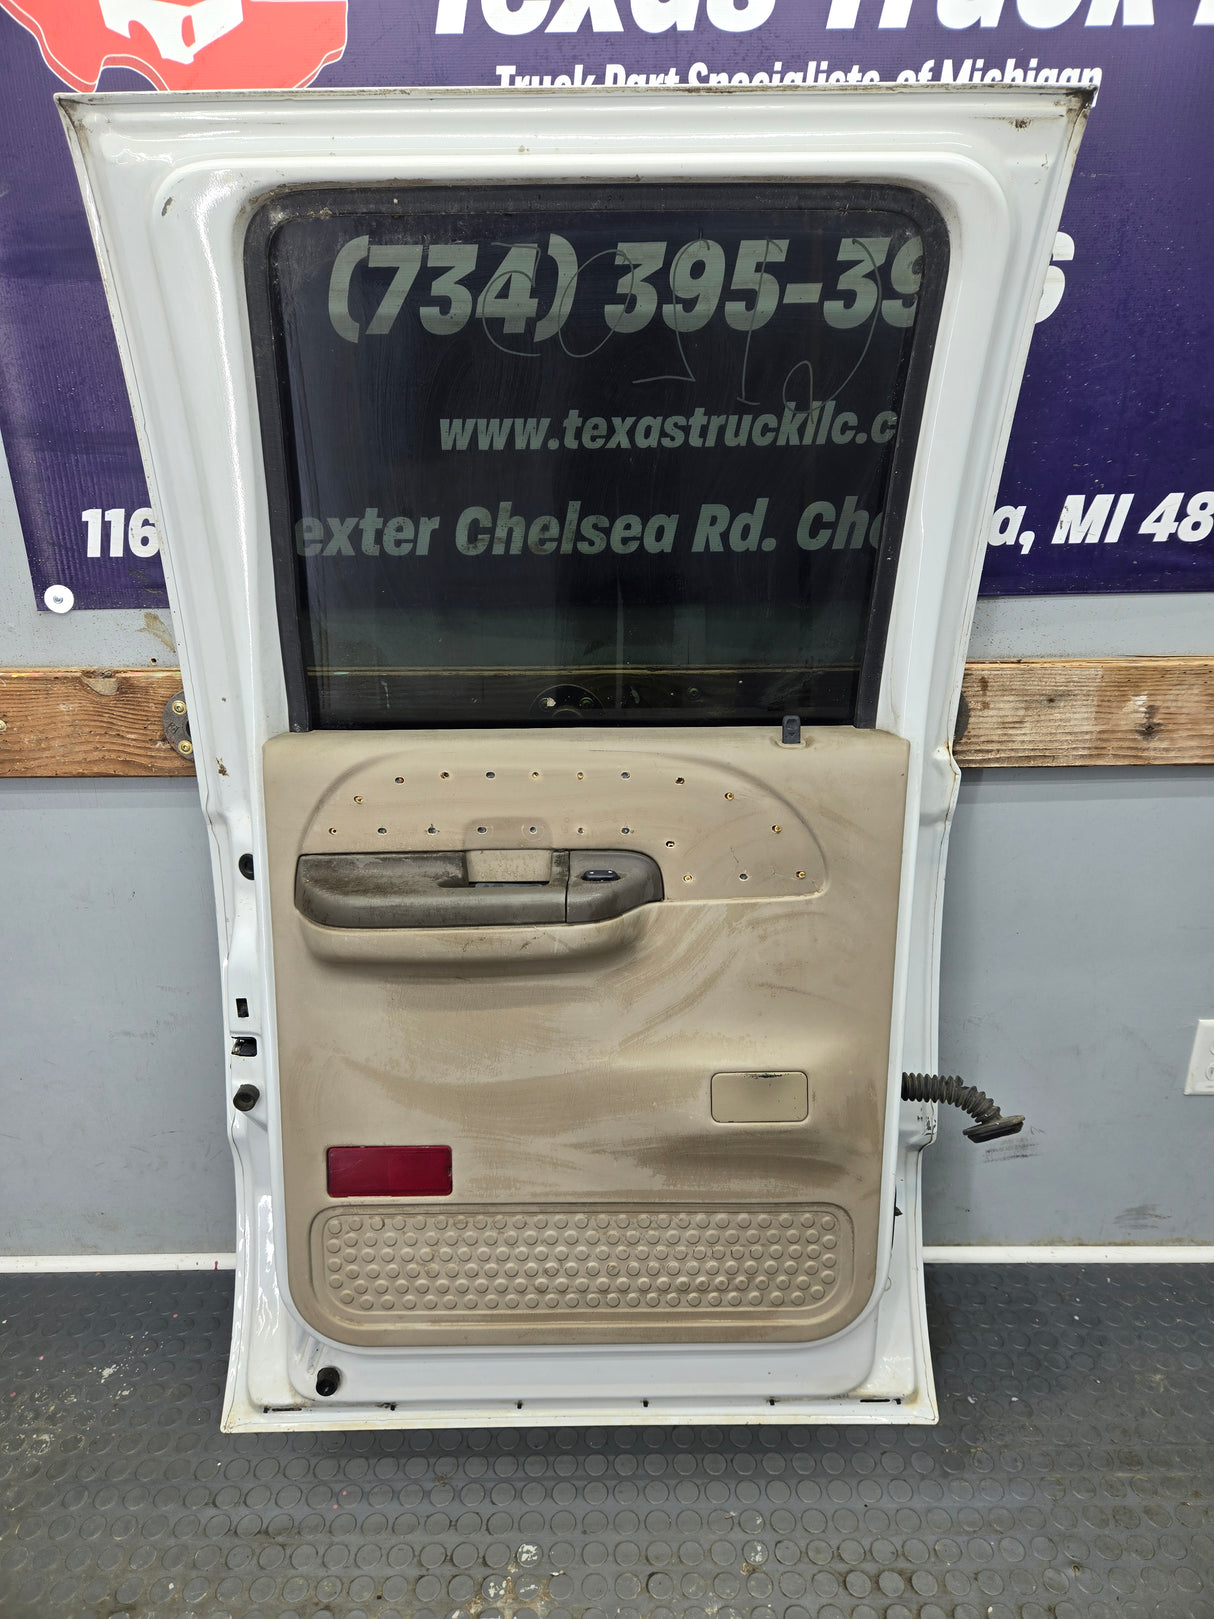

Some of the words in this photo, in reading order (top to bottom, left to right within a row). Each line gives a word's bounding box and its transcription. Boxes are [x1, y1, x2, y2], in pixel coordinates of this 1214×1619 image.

[328, 233, 578, 344] (734)
[440, 400, 898, 451] www.texastruckllc.c
[81, 507, 161, 558] 116
[295, 507, 441, 556] exter
[455, 500, 679, 556] Chelsea
[691, 498, 777, 553] Rd.
[1051, 493, 1135, 545] MI
